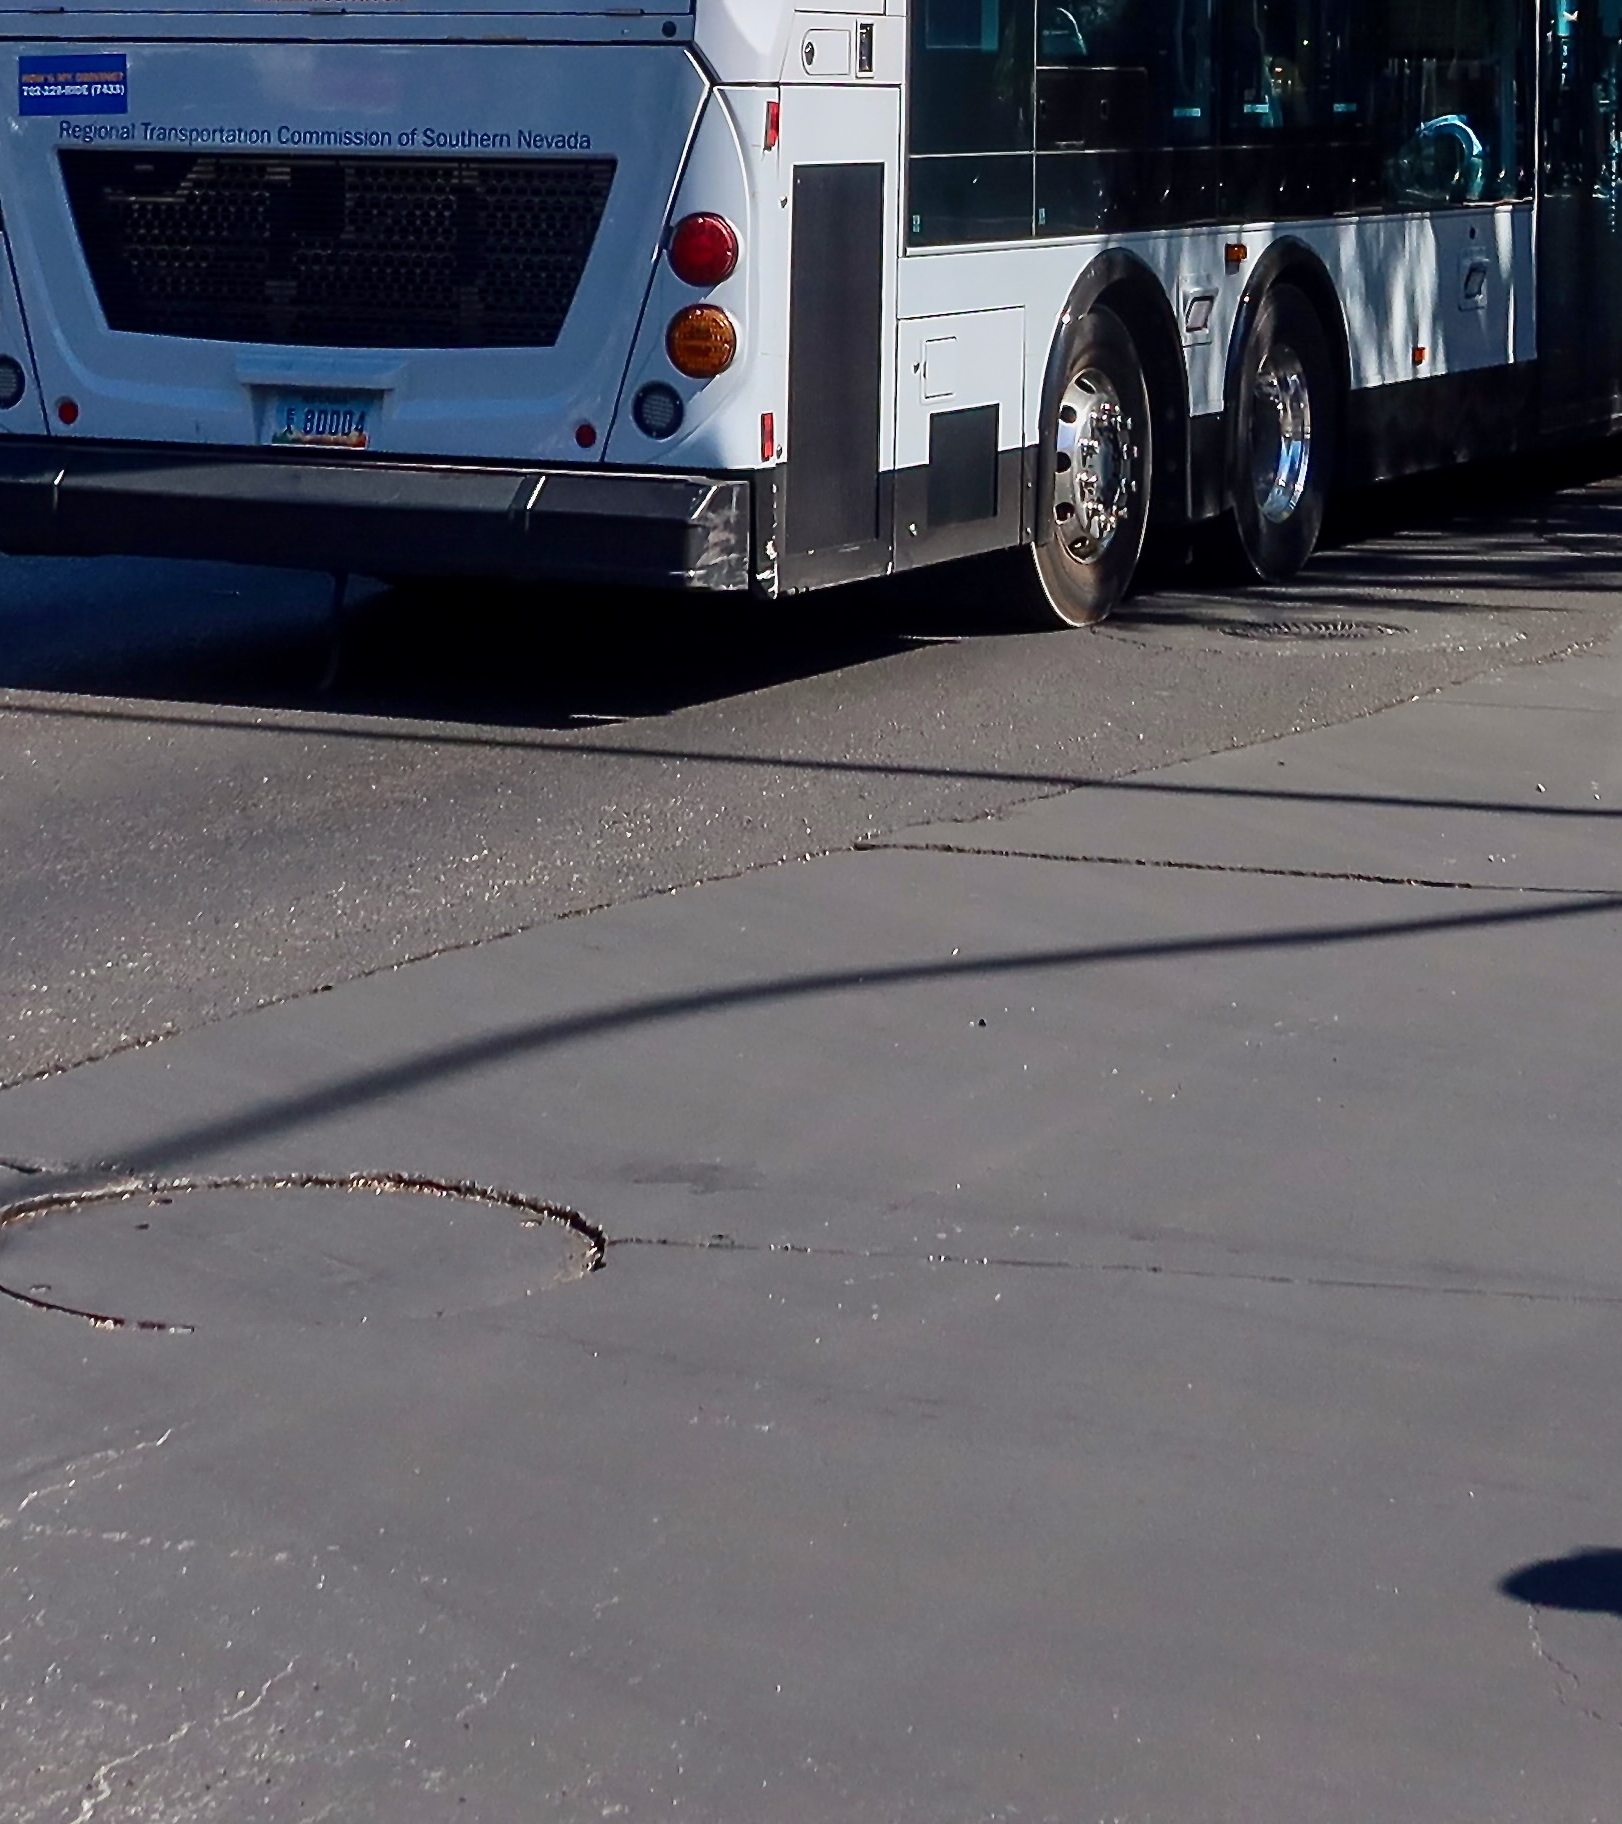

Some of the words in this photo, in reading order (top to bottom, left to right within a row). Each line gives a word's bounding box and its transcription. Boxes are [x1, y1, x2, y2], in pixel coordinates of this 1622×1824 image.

[59, 120, 135, 144] Regional
[142, 122, 271, 148] Transportation
[278, 125, 392, 147] Commission
[398, 127, 417, 147] of
[422, 127, 511, 149] Southern
[518, 130, 591, 150] Nevada
